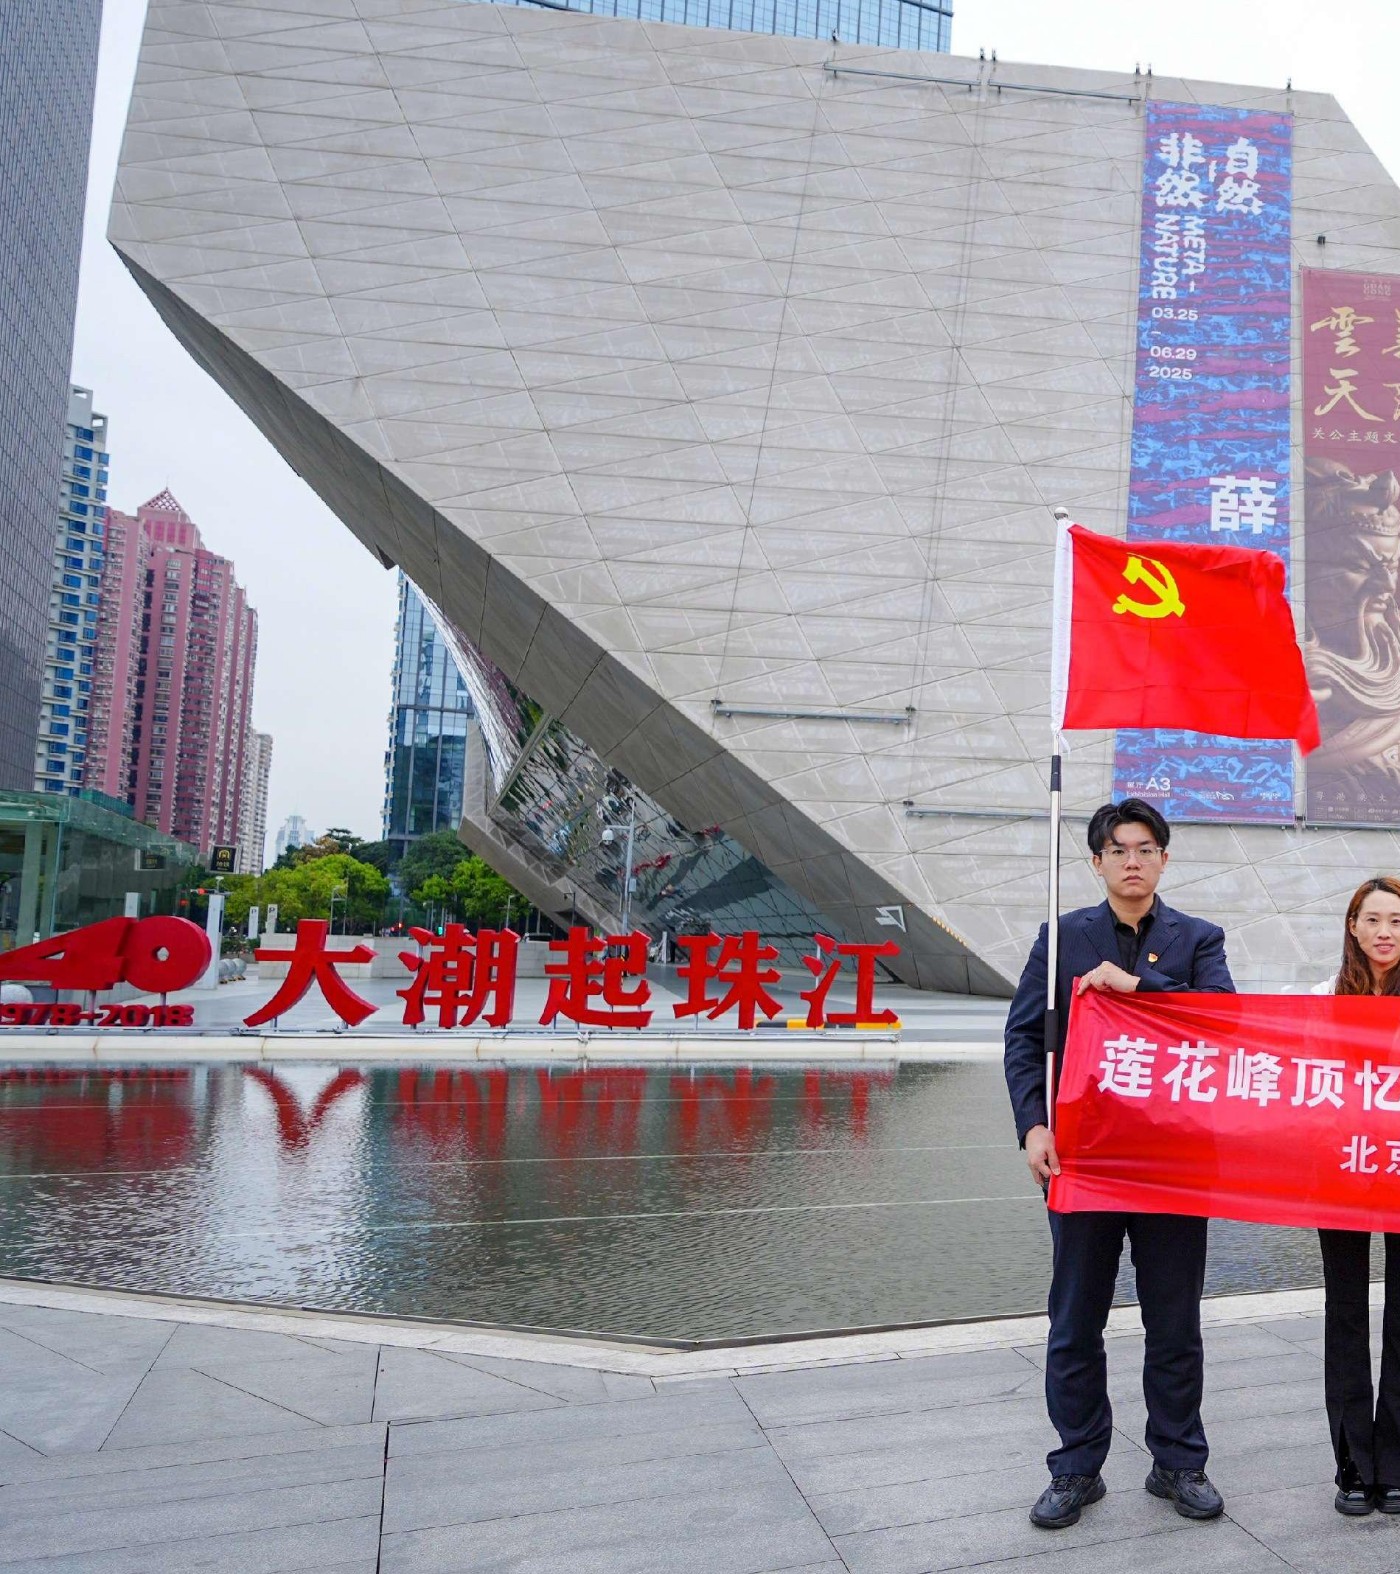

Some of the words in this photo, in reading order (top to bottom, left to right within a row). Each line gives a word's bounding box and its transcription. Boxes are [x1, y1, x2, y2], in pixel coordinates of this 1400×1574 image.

[1151, 213, 1181, 299] NATURE
[1152, 307, 1198, 321] 03.25
[1150, 346, 1197, 360] 06.29
[1149, 366, 1193, 380] 2025
[1210, 476, 1277, 534] 薛
[1146, 777, 1171, 791] A3
[243, 917, 903, 1031] 大潮起珠江
[0, 1002, 194, 1027] 978-2018
